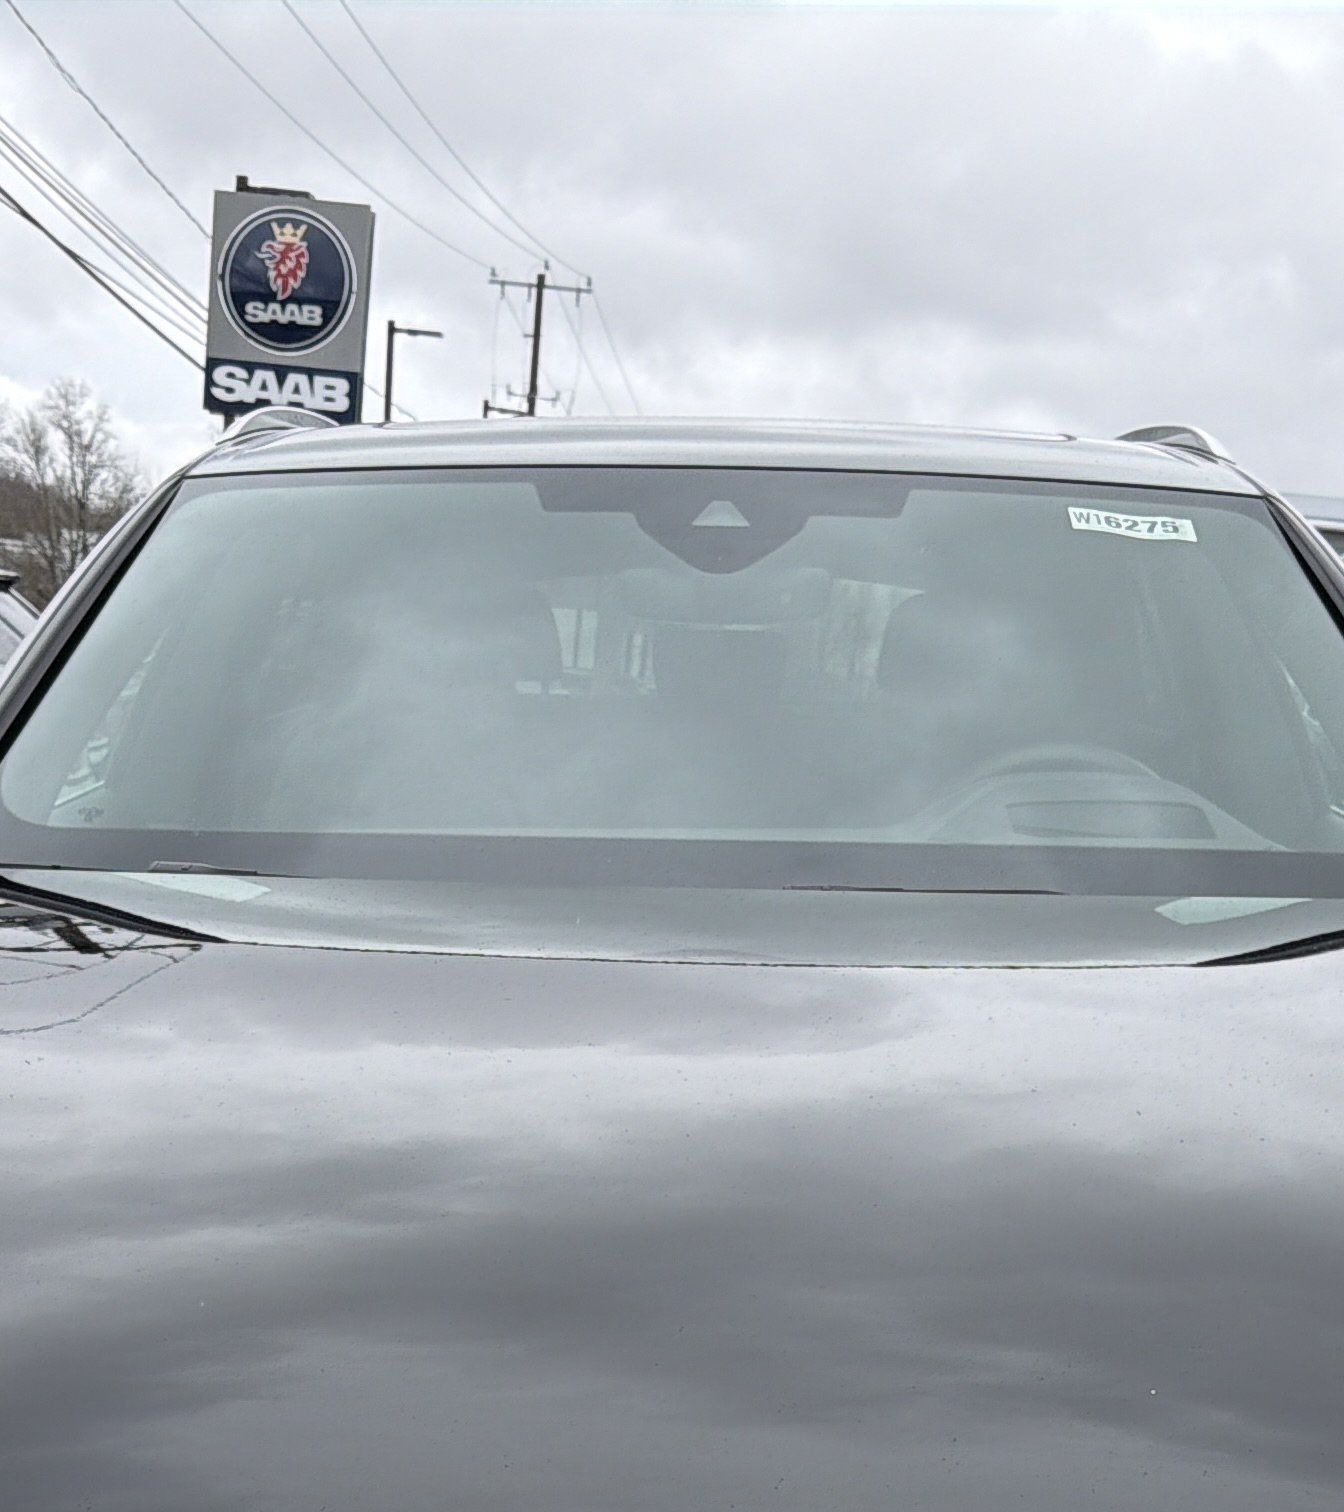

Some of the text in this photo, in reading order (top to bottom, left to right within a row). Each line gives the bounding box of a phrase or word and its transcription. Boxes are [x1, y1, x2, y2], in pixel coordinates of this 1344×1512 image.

[244, 301, 323, 326] SAAB
[209, 365, 350, 412] SAAB
[1072, 511, 1180, 534] W16275
